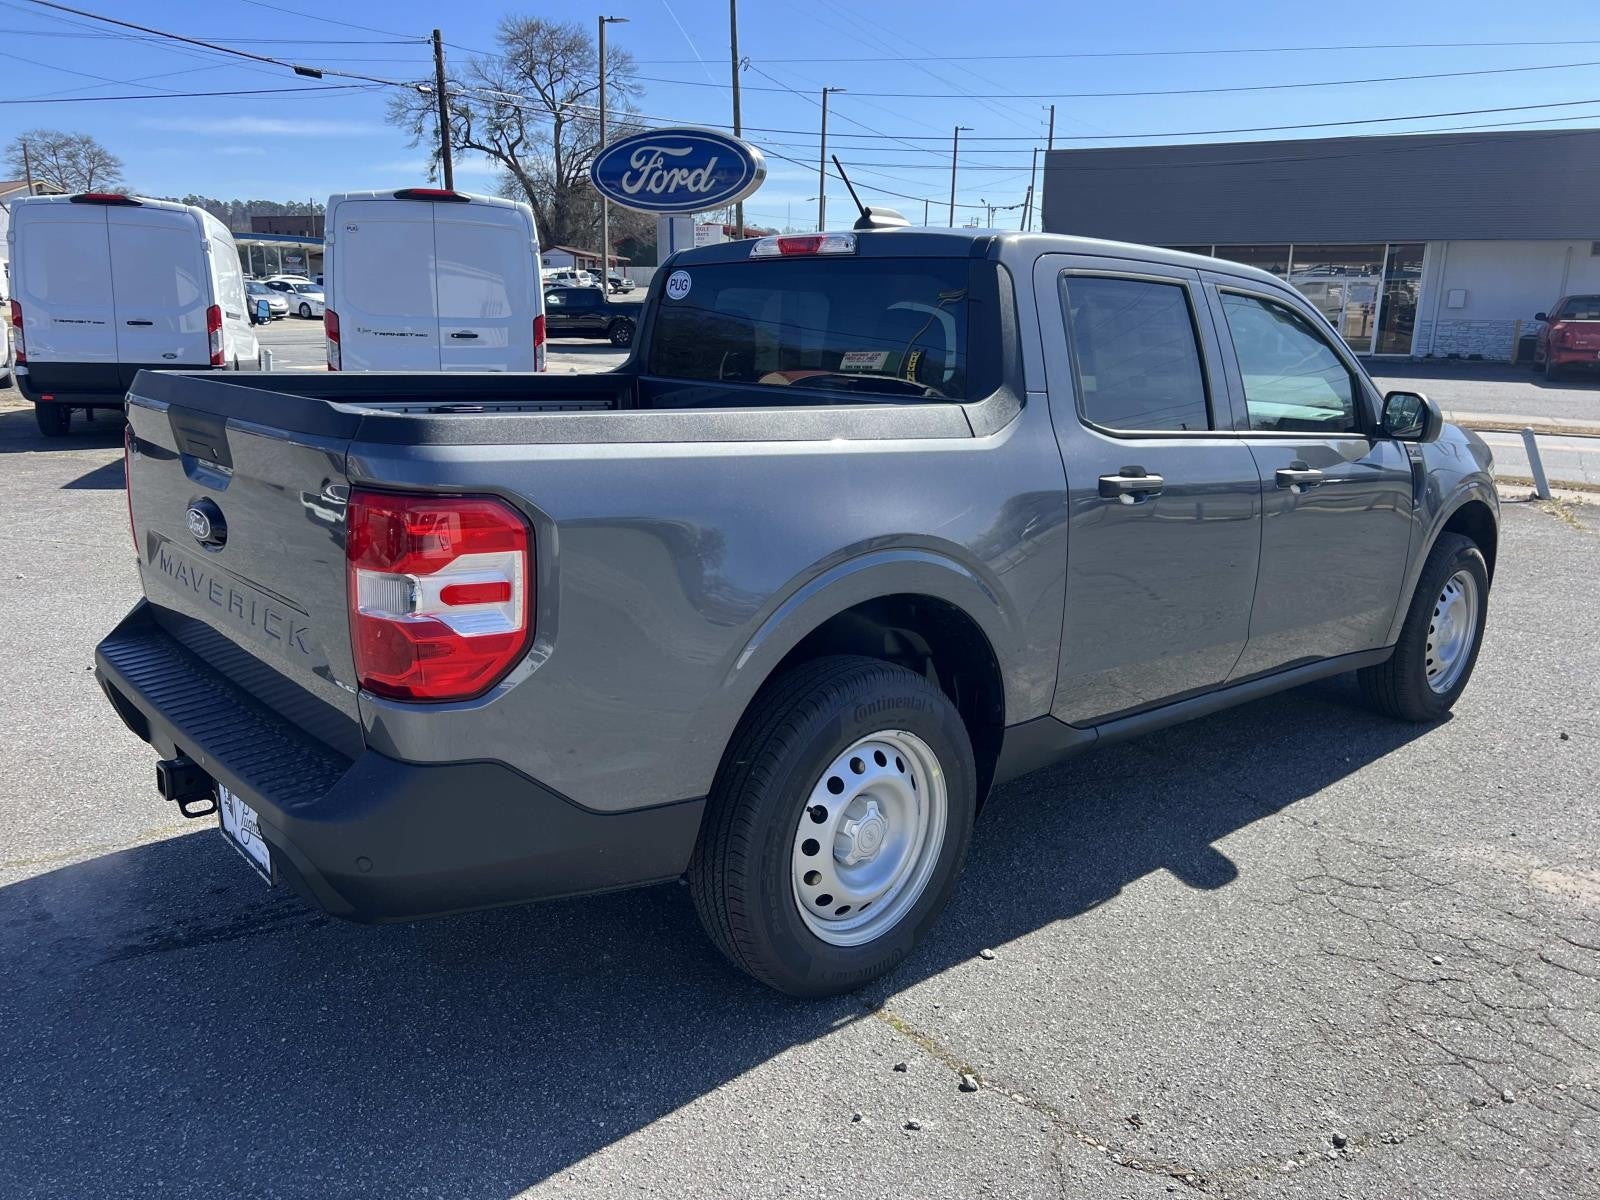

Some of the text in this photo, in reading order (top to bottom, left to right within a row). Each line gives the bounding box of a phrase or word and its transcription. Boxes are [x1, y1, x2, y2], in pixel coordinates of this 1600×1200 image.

[622, 146, 719, 193] Ford
[669, 278, 689, 291] PUG
[188, 510, 204, 534] Ford
[159, 548, 314, 655] MAVERICK
[853, 695, 927, 724] Continental
